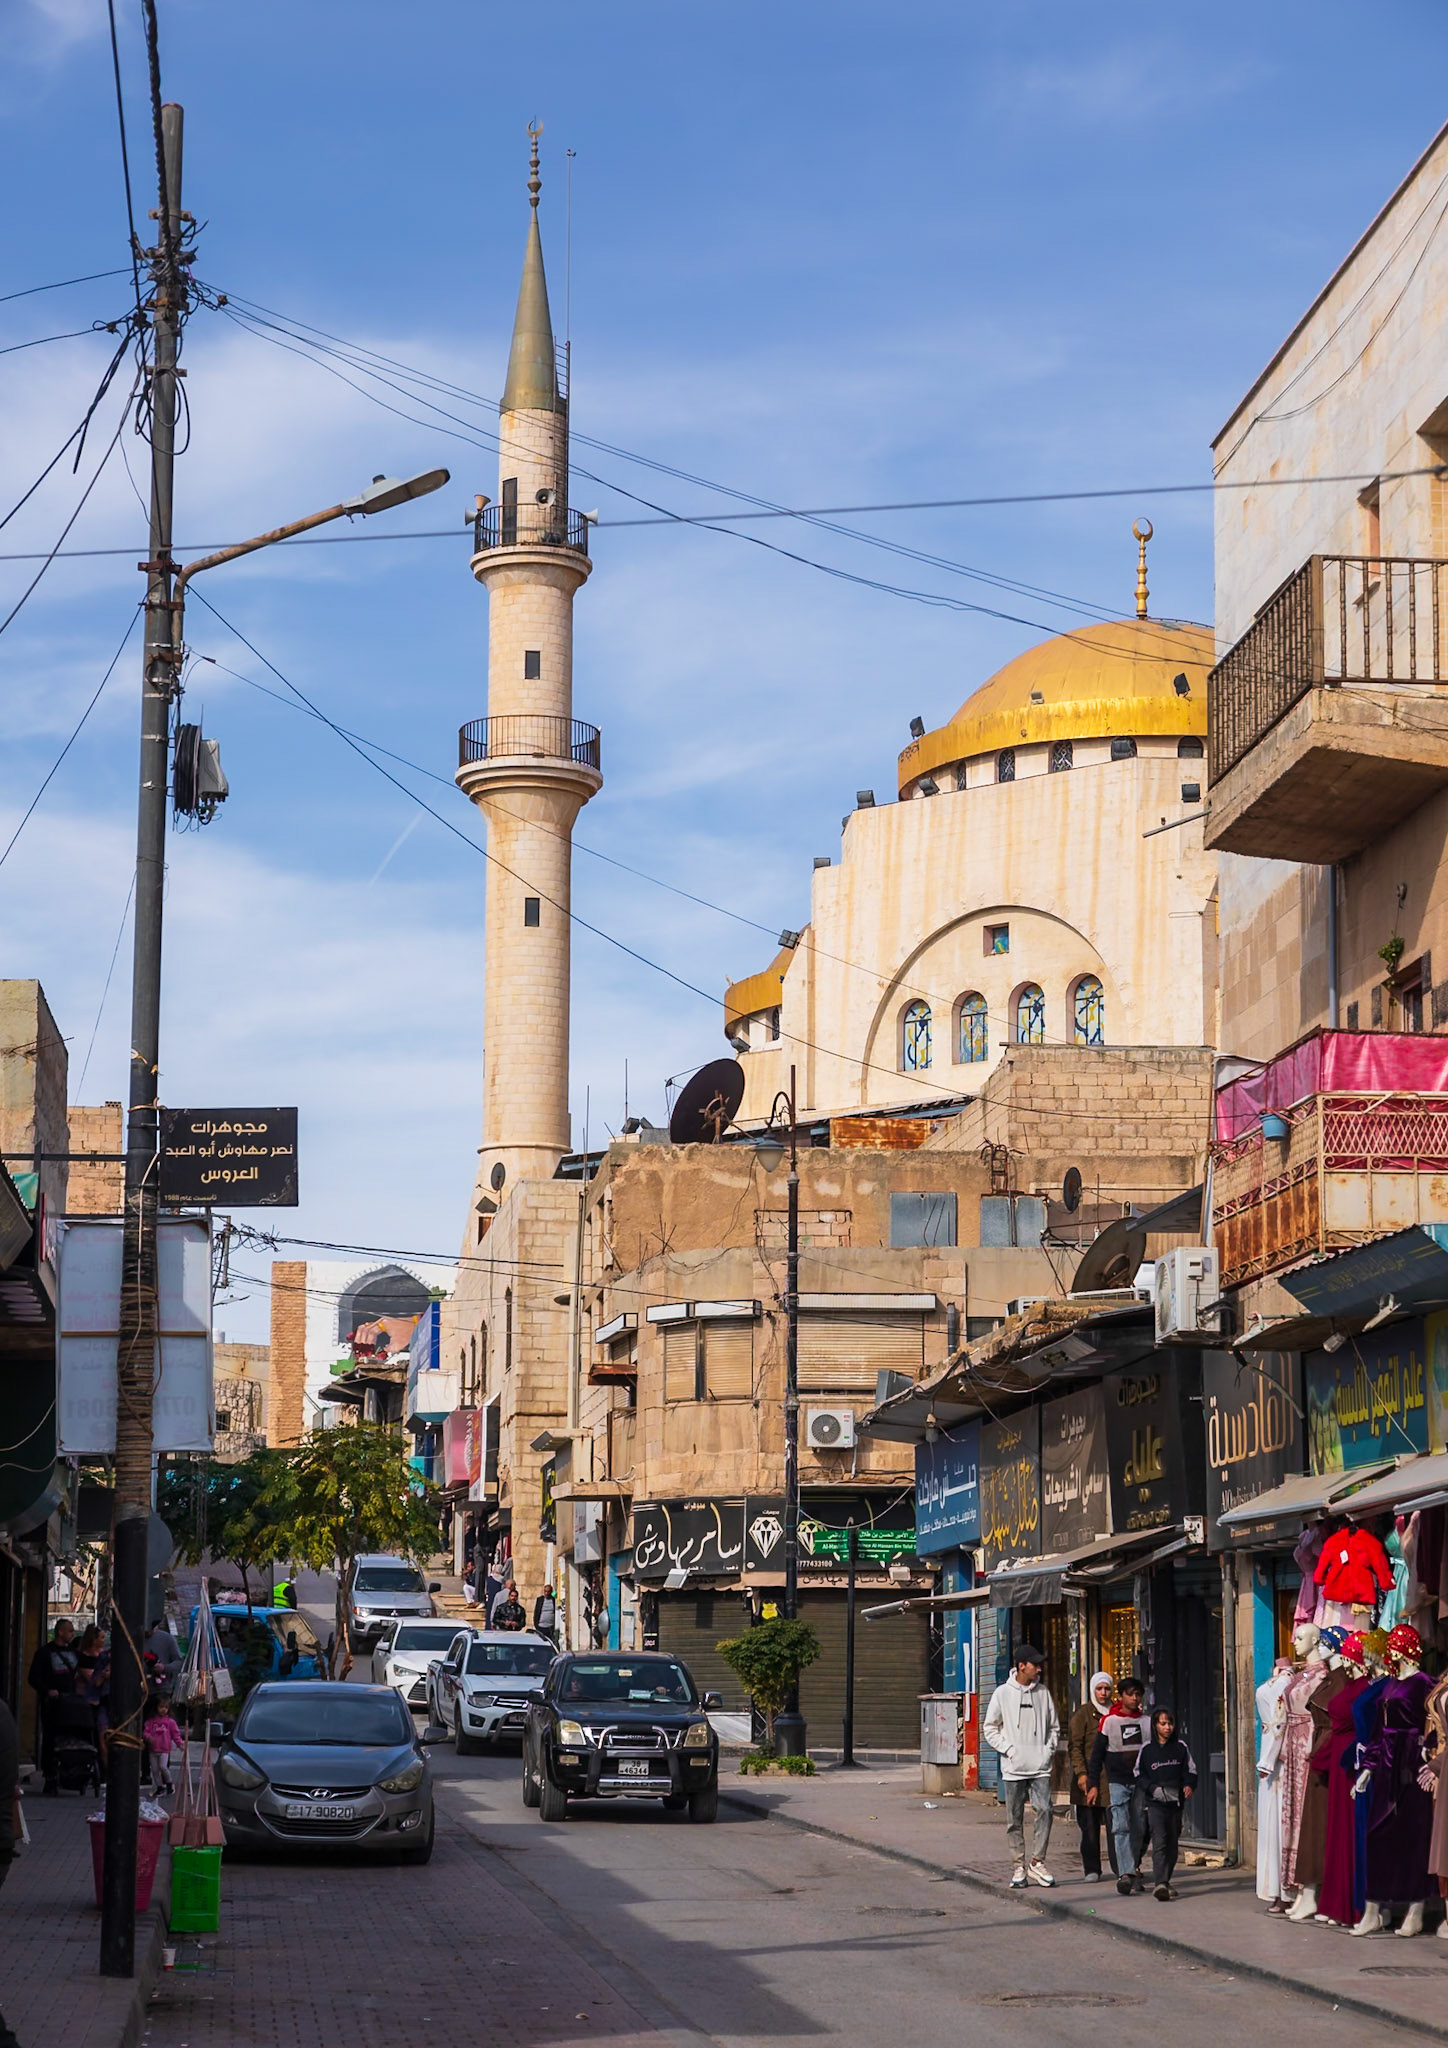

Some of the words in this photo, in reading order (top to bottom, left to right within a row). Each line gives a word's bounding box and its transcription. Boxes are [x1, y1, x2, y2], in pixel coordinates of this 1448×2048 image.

[191, 1120, 268, 1136] مجوهرات
[165, 1145, 195, 1158] العبد
[198, 1140, 216, 1157] أبو
[217, 1143, 268, 1158] مهاوش
[270, 1144, 293, 1157] نصر
[200, 1167, 258, 1183] العروس
[1403, 1350, 1424, 1430] عالم
[1082, 1462, 1104, 1514] سامي
[635, 1503, 695, 1569] مهاوش
[689, 1502, 742, 1564] سامر
